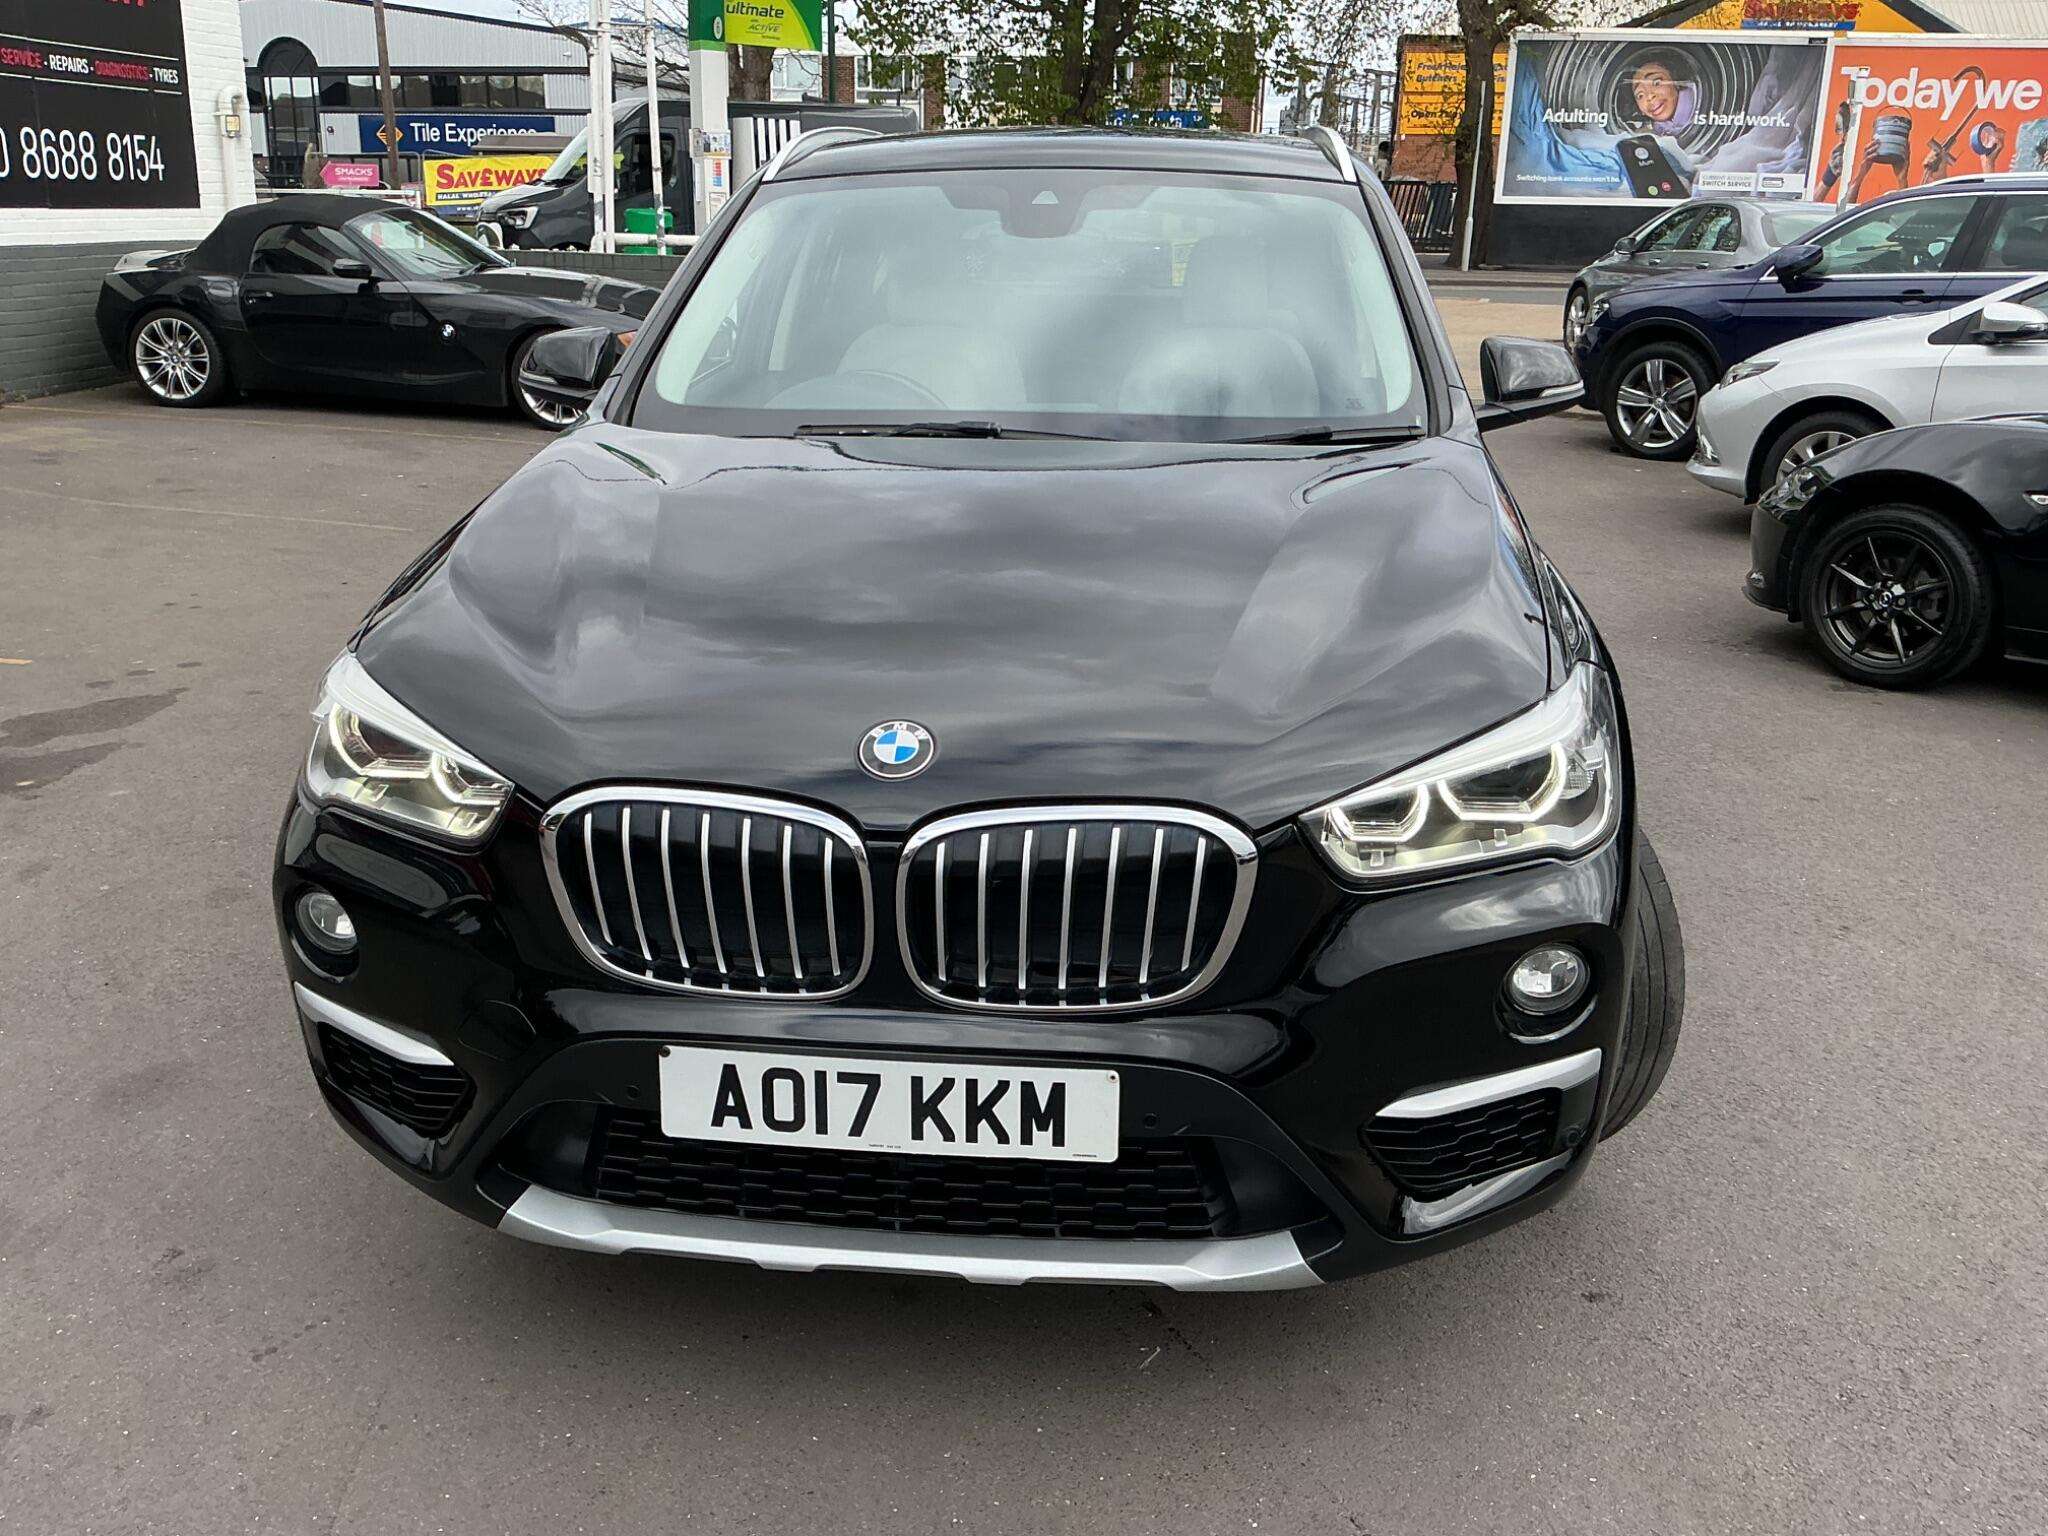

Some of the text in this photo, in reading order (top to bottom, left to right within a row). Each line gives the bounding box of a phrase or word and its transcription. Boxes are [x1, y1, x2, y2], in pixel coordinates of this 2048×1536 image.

[726, 2, 785, 18] ultimate
[0, 47, 43, 69] SERVICE
[49, 54, 89, 74] REPAIRS
[153, 67, 179, 84] TYRES
[1841, 66, 2043, 121] Today we
[1542, 107, 1791, 128] Adulting is hard work.
[409, 122, 441, 142] Tile
[19, 126, 98, 180] 8688
[106, 132, 165, 182] 8154
[335, 167, 373, 177] SMACKS
[437, 192, 459, 200] HALAL
[711, 1063, 1067, 1148] AO17 KKM
